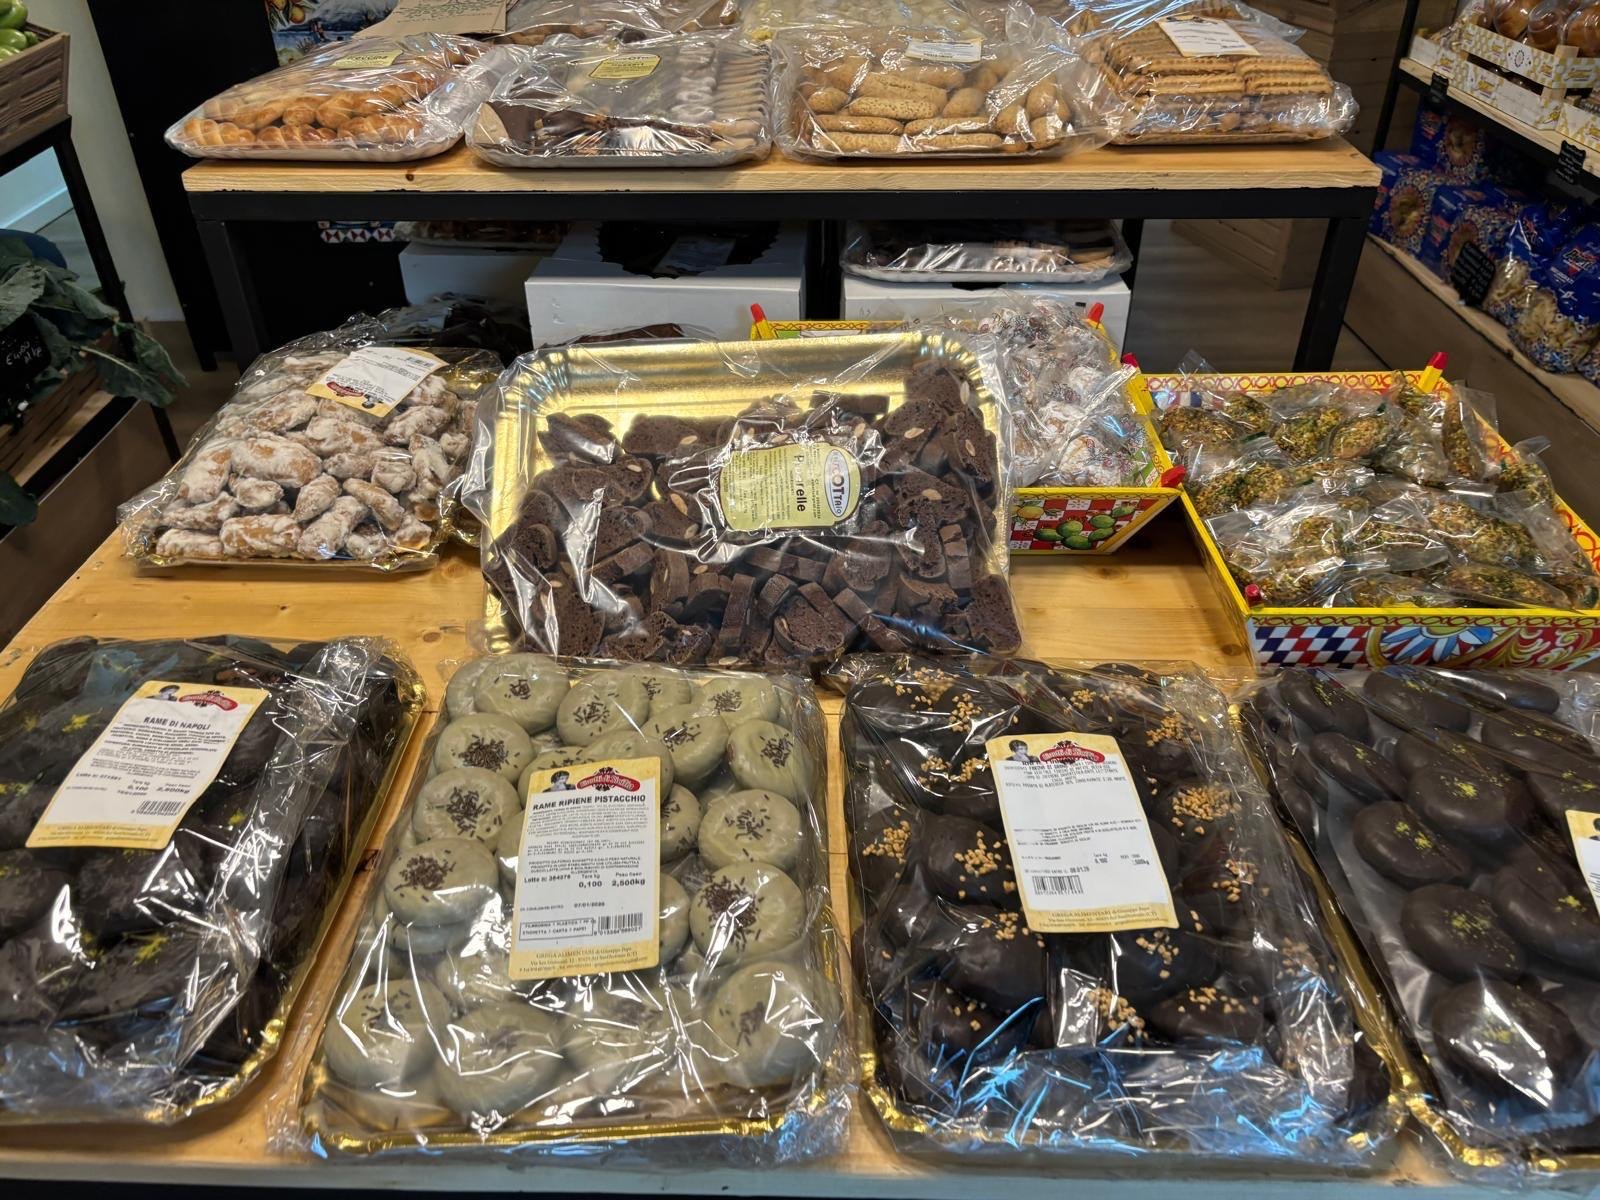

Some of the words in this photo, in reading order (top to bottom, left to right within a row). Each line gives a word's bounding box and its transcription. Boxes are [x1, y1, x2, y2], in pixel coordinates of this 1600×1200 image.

[144, 717, 168, 726] RAME
[169, 720, 178, 728] DI
[180, 721, 210, 730] NAPOLI
[533, 801, 556, 811] RAME
[559, 797, 592, 806] RIPIENE
[594, 795, 646, 803] PISTACCHIO
